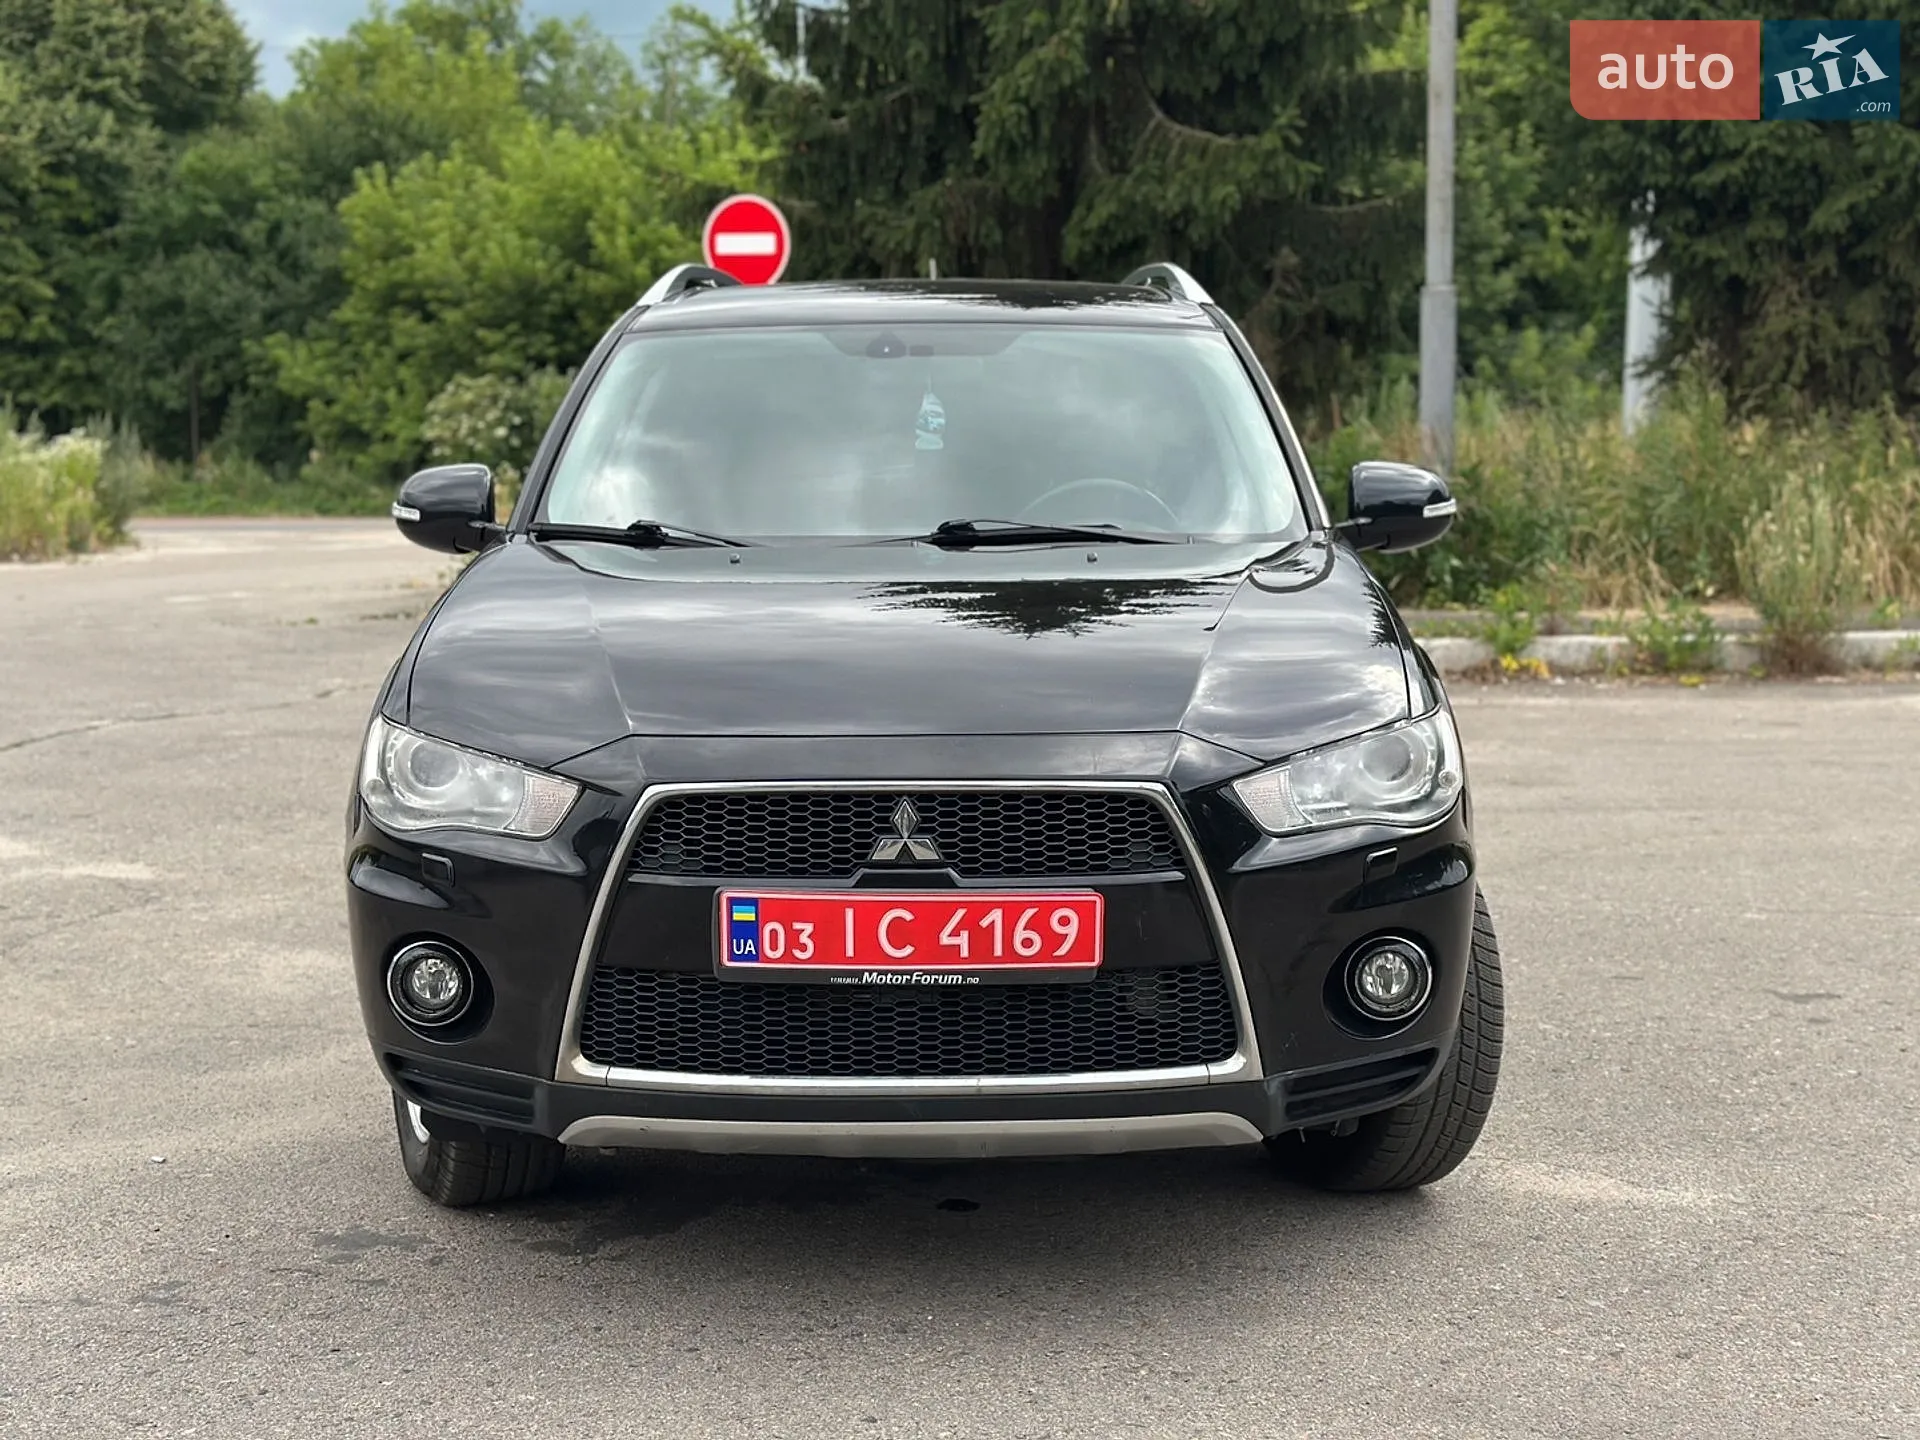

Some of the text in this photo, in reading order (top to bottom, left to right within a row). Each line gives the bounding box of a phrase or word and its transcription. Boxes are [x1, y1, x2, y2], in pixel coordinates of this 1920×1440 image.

[733, 938, 756, 955] UA
[762, 921, 815, 960] 03
[939, 907, 1080, 958] 4169
